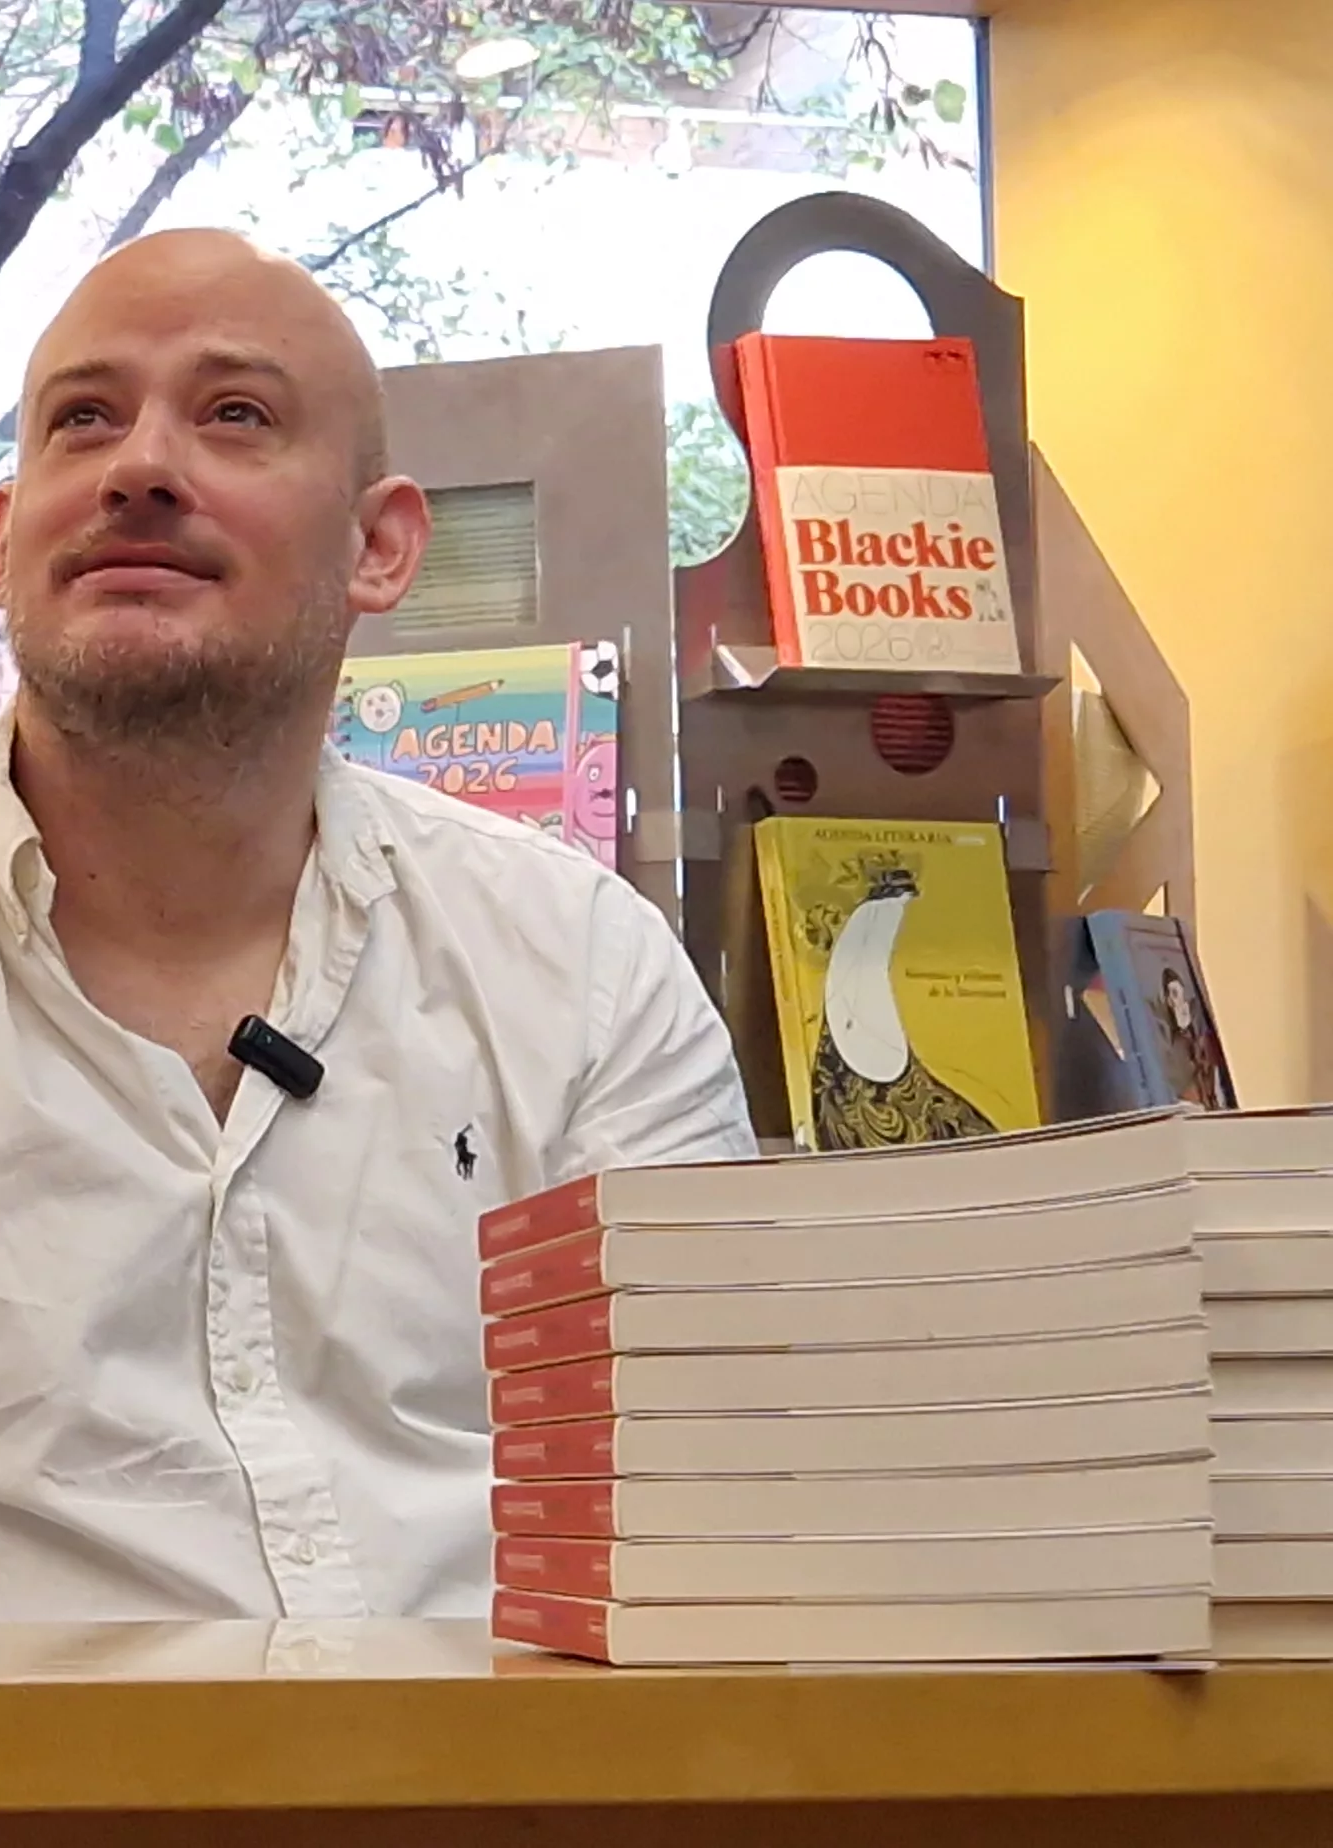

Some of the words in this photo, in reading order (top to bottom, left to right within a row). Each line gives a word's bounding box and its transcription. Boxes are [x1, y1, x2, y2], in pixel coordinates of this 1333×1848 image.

[791, 471, 987, 517] AGENDA
[792, 518, 996, 571] Blackie
[799, 569, 973, 620] Books
[808, 621, 914, 661] 2026
[392, 718, 559, 763] AGENDA
[417, 757, 519, 794] 2026
